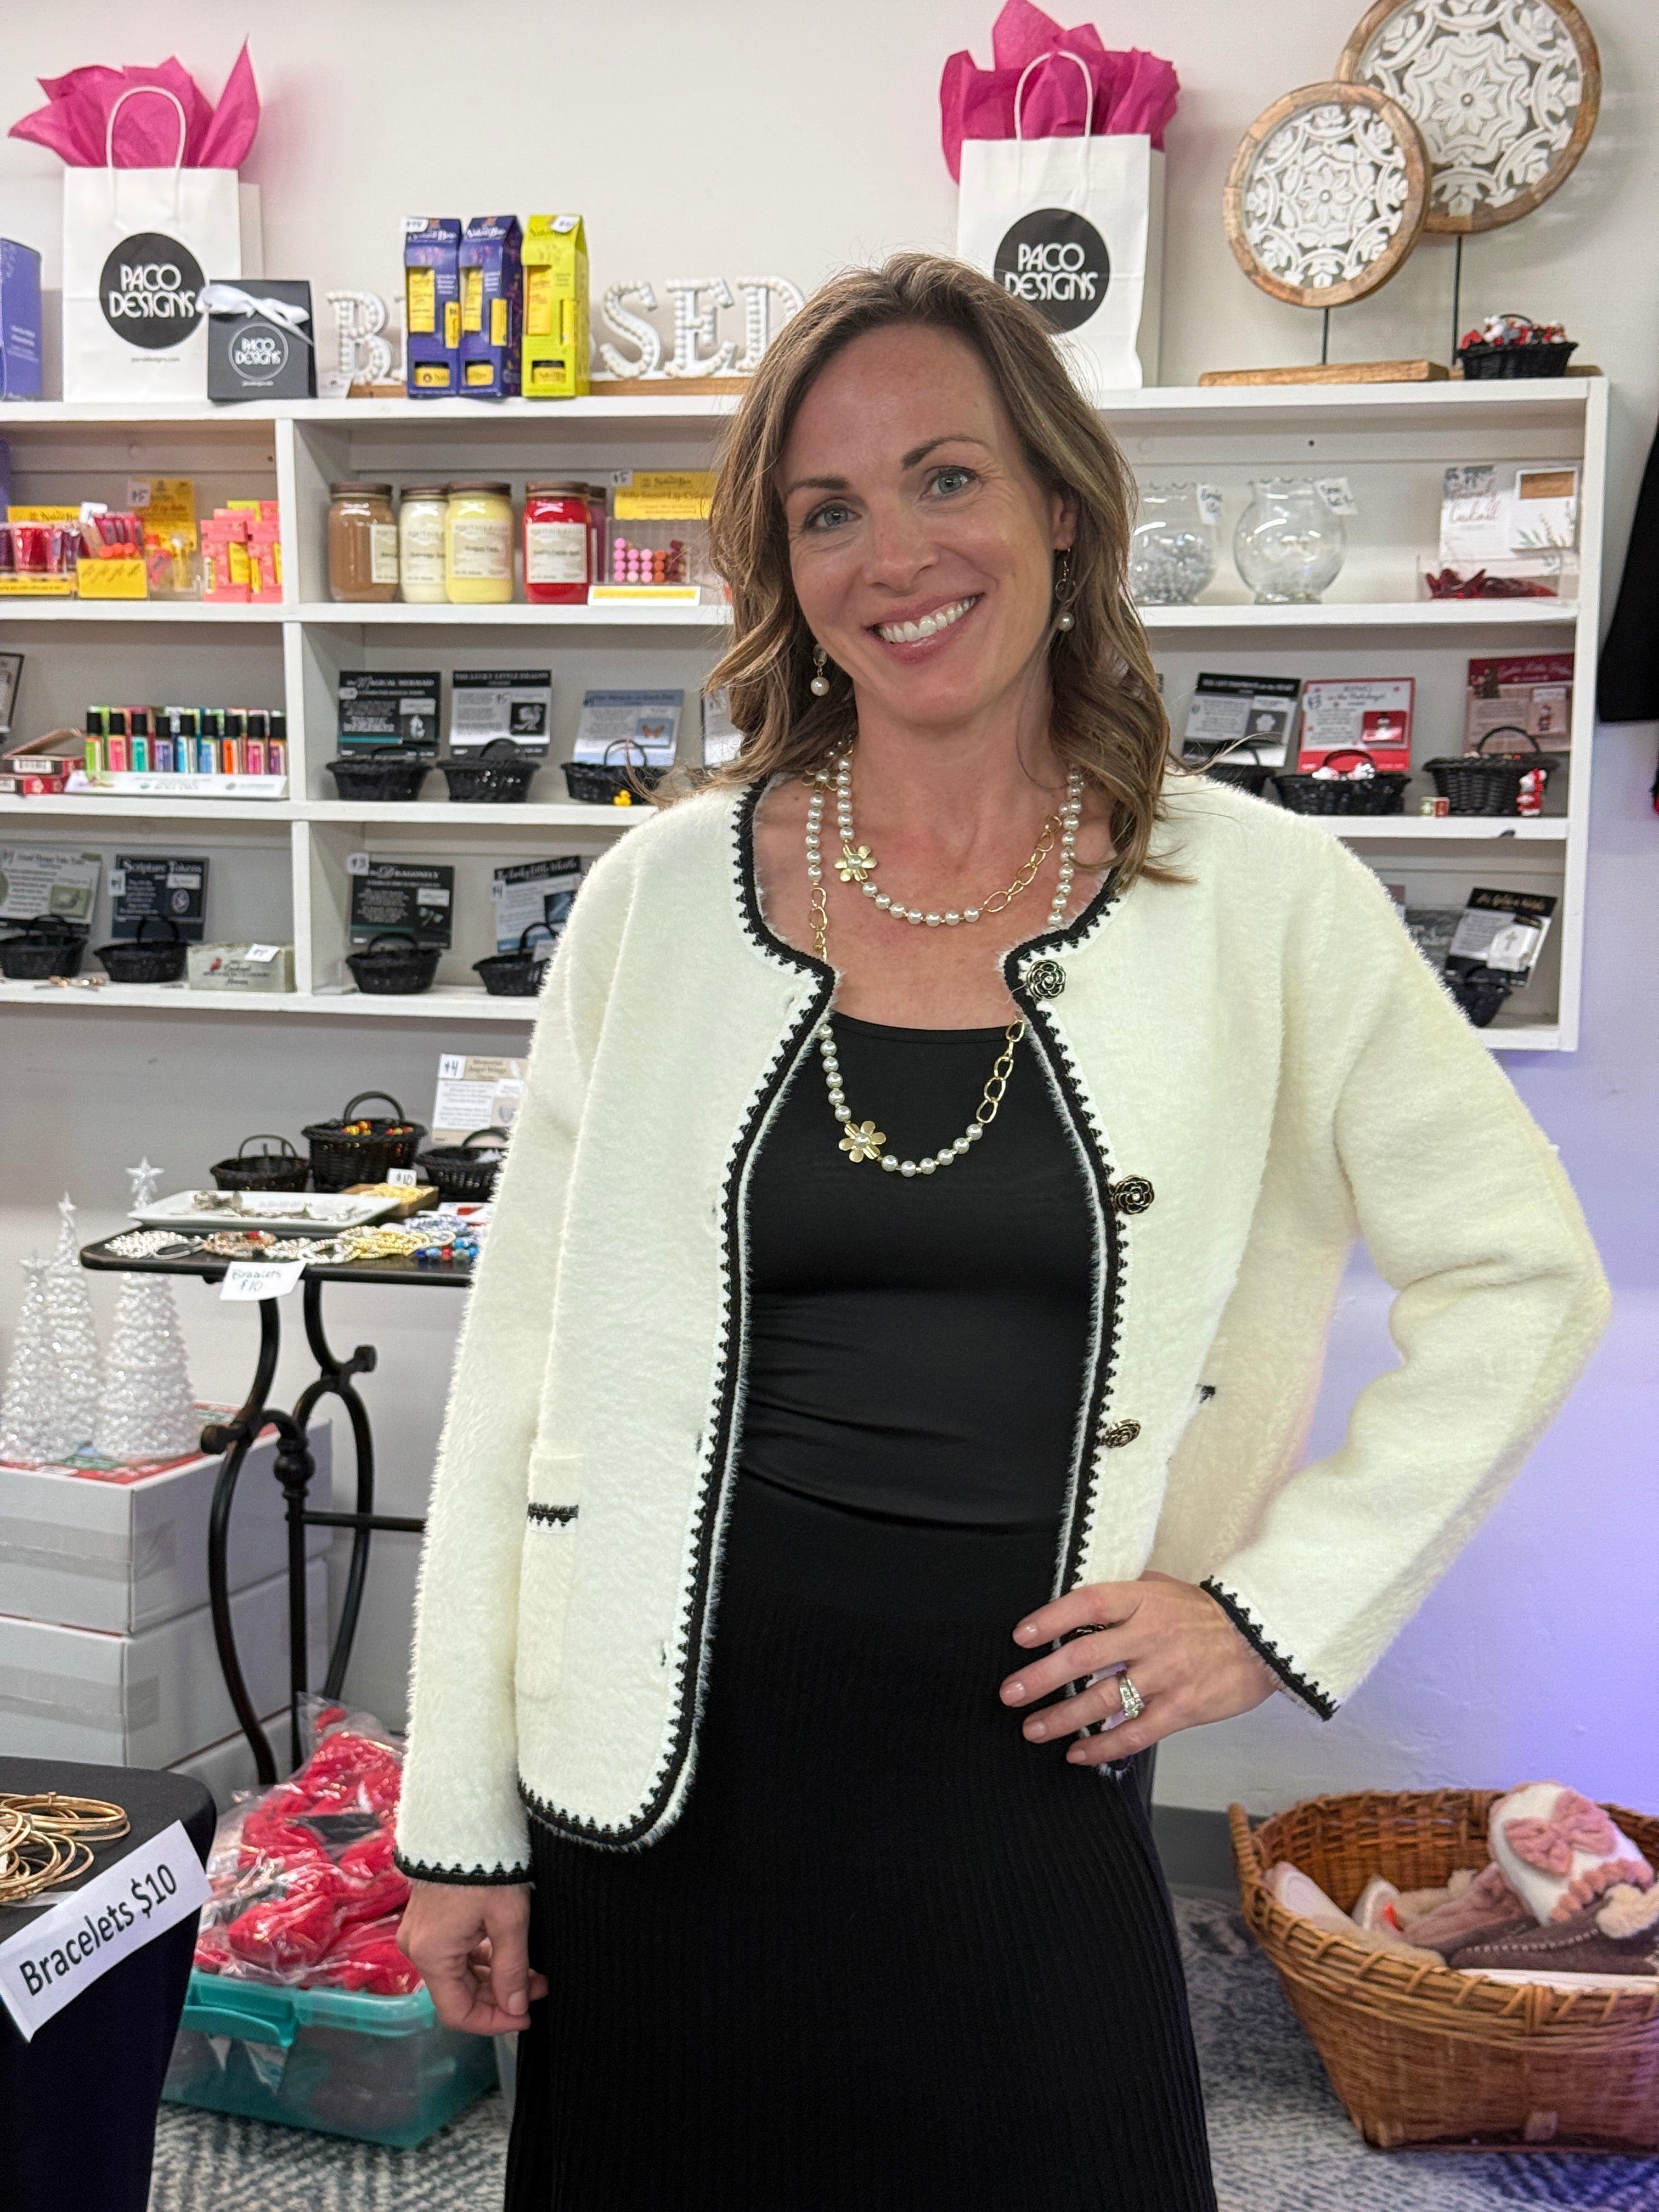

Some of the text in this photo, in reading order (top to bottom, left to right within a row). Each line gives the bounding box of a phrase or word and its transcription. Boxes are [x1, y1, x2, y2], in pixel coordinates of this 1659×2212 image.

[1018, 242, 1085, 272] PACO
[120, 262, 182, 292] PACO
[1005, 270, 1098, 301] DESIGNS
[109, 291, 196, 318] DESIGNS
[234, 349, 281, 365] DESIGNS
[241, 337, 275, 352] PACO
[18, 1863, 177, 1997] Bracelets $10
